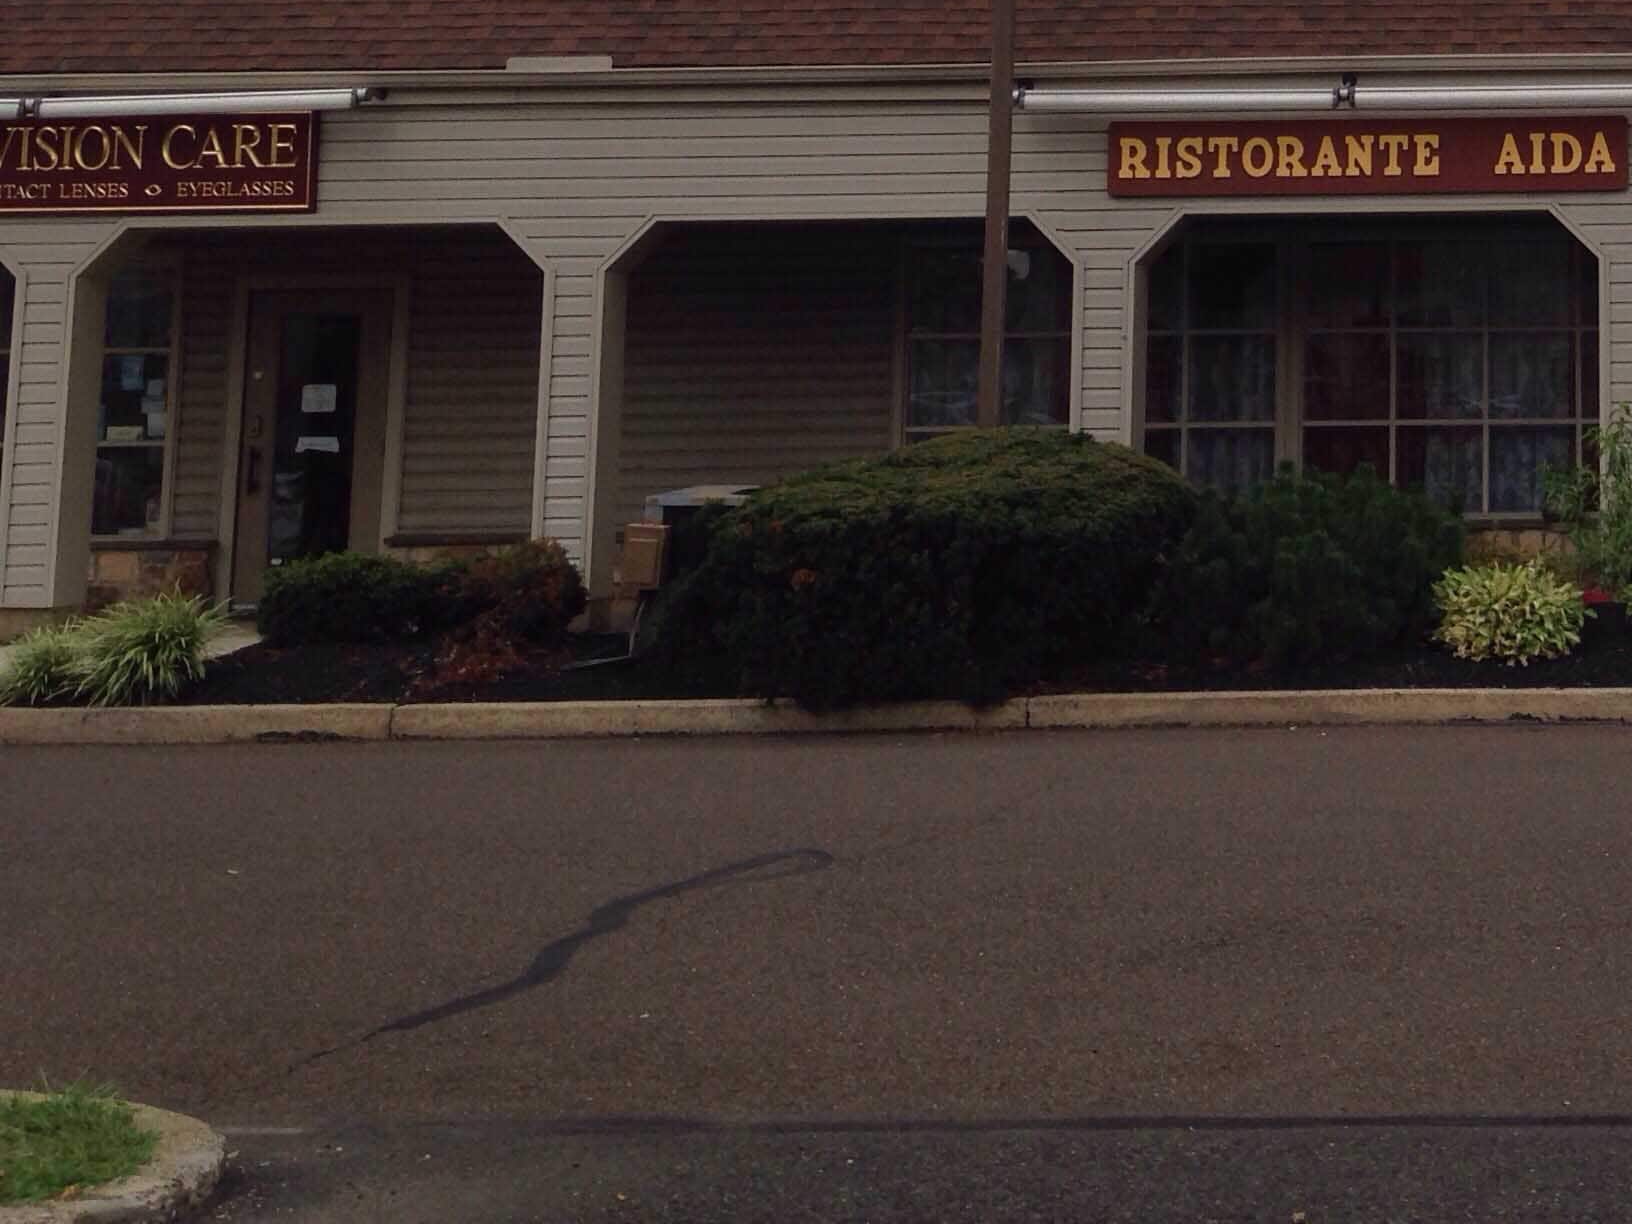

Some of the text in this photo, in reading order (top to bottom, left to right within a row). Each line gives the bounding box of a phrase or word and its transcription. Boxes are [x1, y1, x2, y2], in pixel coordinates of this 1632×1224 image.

[162, 124, 297, 169] CARE
[1118, 131, 1616, 178] RISTORANTE AIDA
[0, 180, 294, 200] TACT LENSES EYEGLASSES
